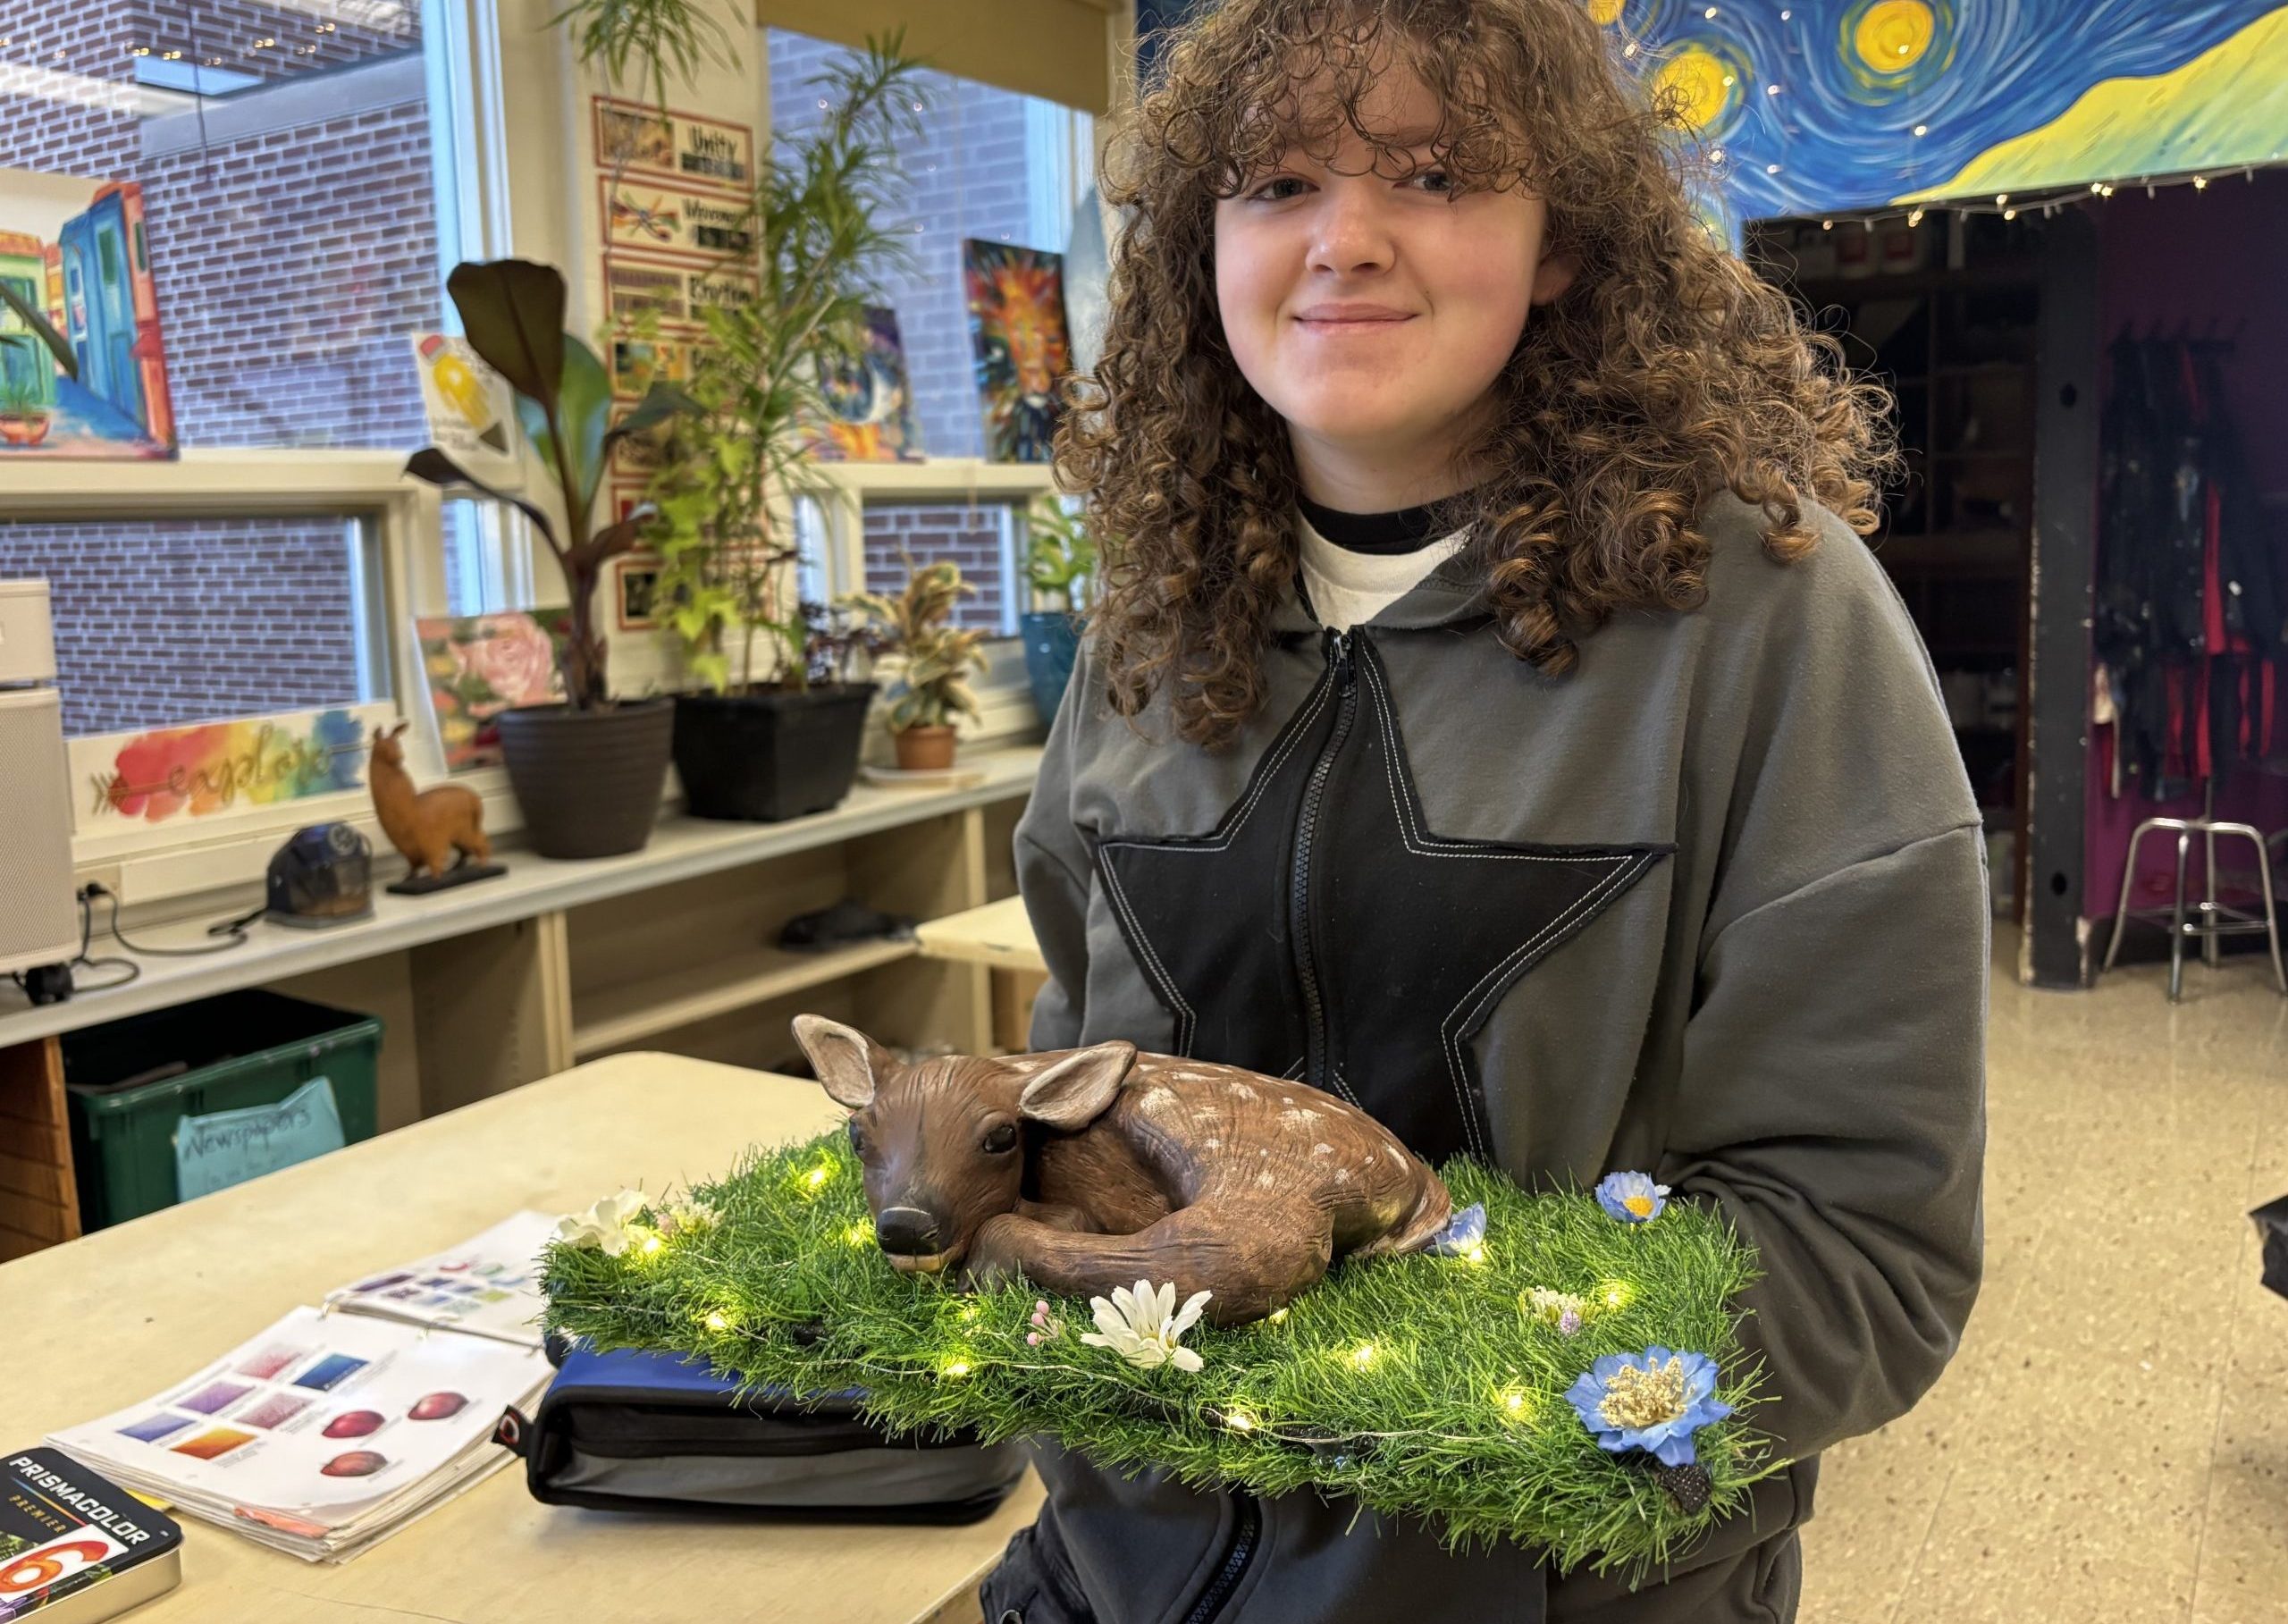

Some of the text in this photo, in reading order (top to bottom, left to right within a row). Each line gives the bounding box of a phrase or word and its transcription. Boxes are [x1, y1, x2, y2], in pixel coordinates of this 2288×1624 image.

[689, 125, 737, 161] Unity
[167, 719, 332, 806] explore
[8, 1456, 151, 1545] PRISMACOLOR
[9, 1494, 67, 1534] PREMIER
